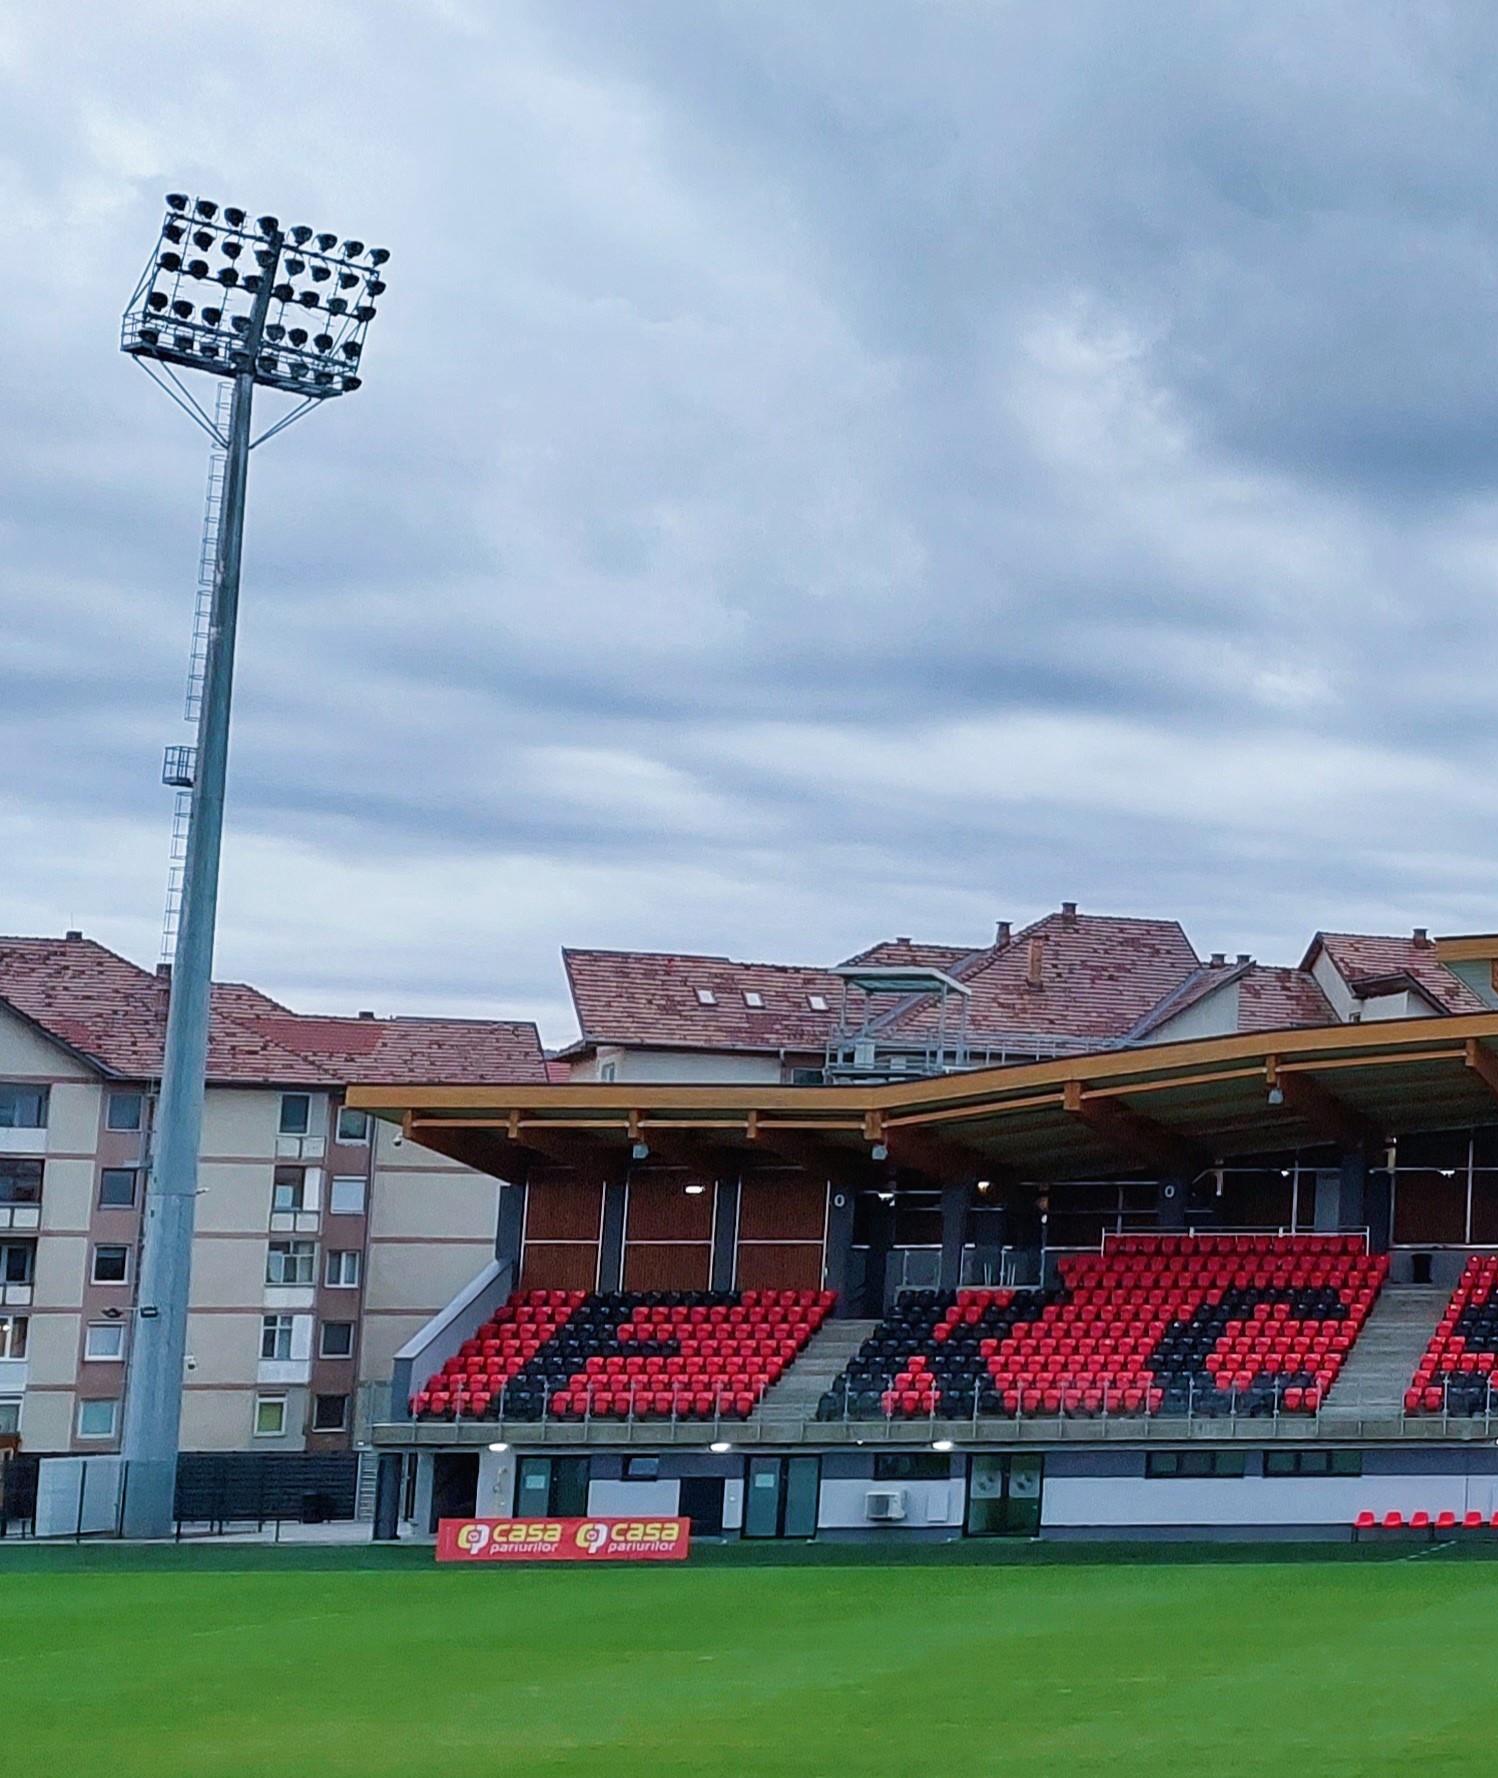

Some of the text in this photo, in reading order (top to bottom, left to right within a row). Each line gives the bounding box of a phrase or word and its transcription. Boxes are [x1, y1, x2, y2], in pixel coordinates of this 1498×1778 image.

[492, 1523, 563, 1541] casa
[610, 1522, 680, 1541] casa
[489, 1540, 559, 1554] pariurilor
[607, 1540, 676, 1553] pariurilor
